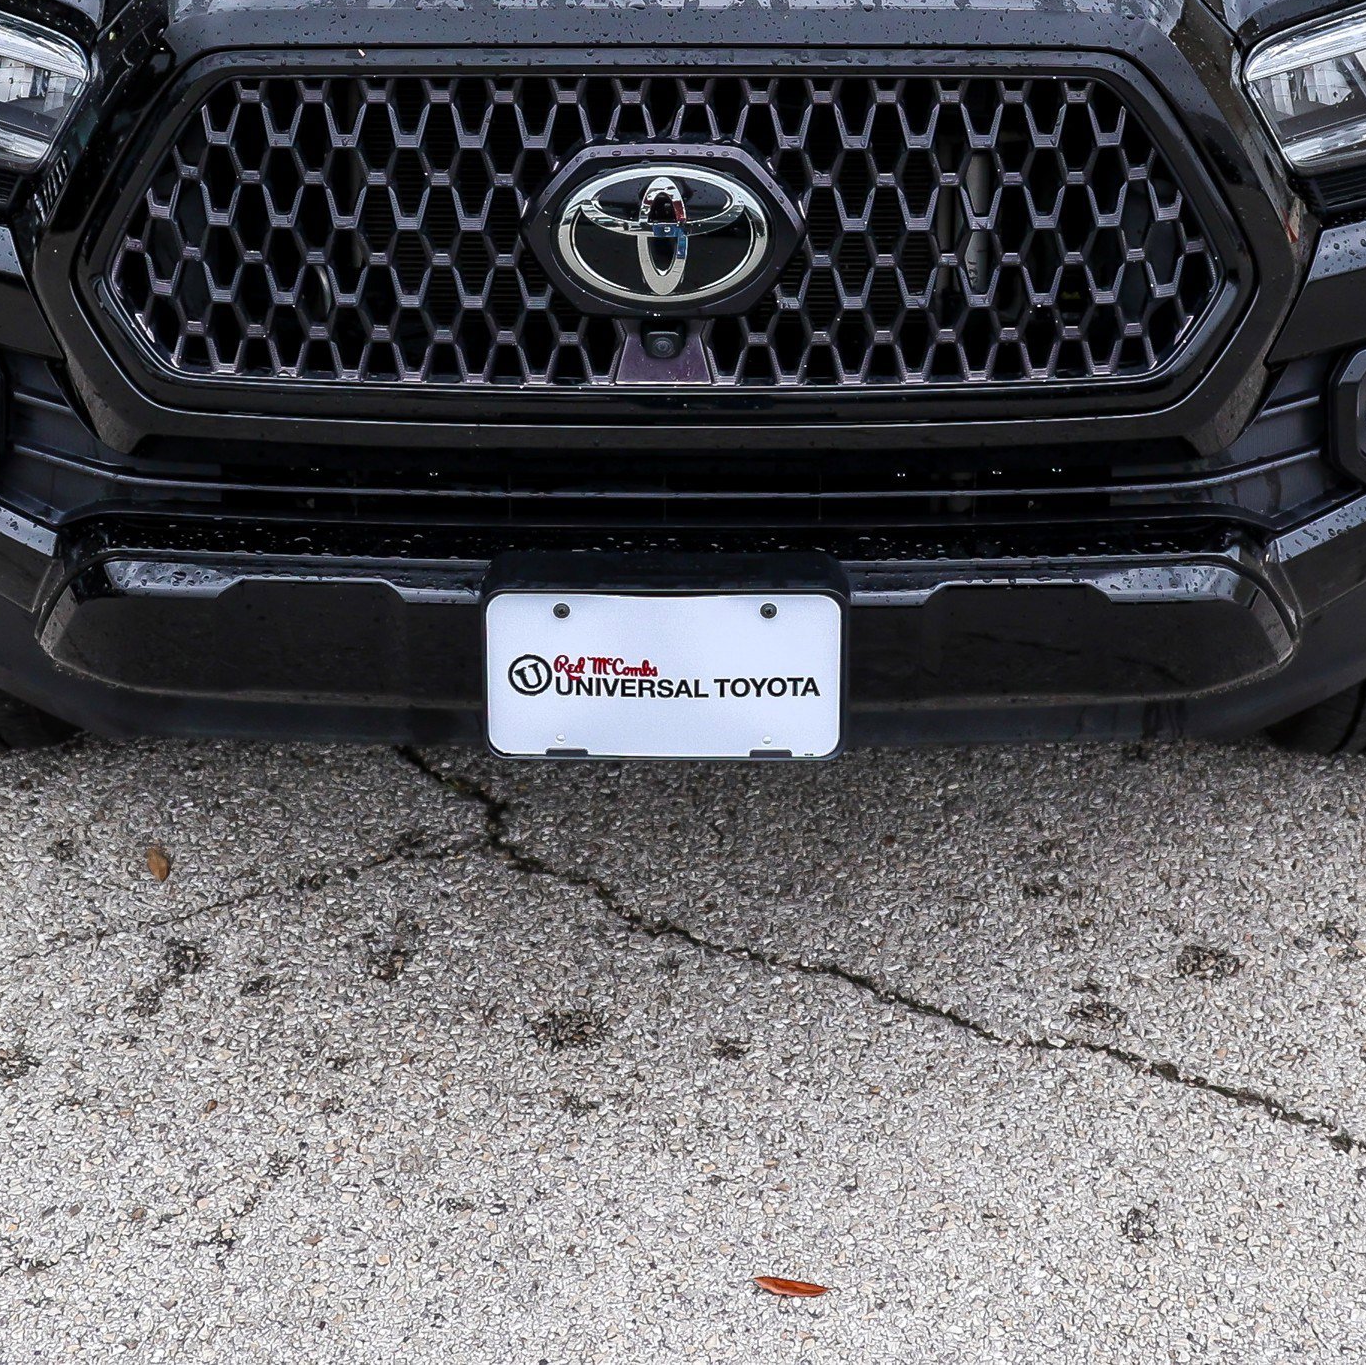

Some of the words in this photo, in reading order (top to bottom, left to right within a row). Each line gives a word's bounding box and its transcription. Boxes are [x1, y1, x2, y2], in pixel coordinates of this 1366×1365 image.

[513, 662, 543, 690] U
[554, 655, 586, 680] Red
[587, 657, 658, 677] McCombs
[555, 676, 710, 699] UNIVERSAL
[713, 677, 821, 698] TOYOTA
